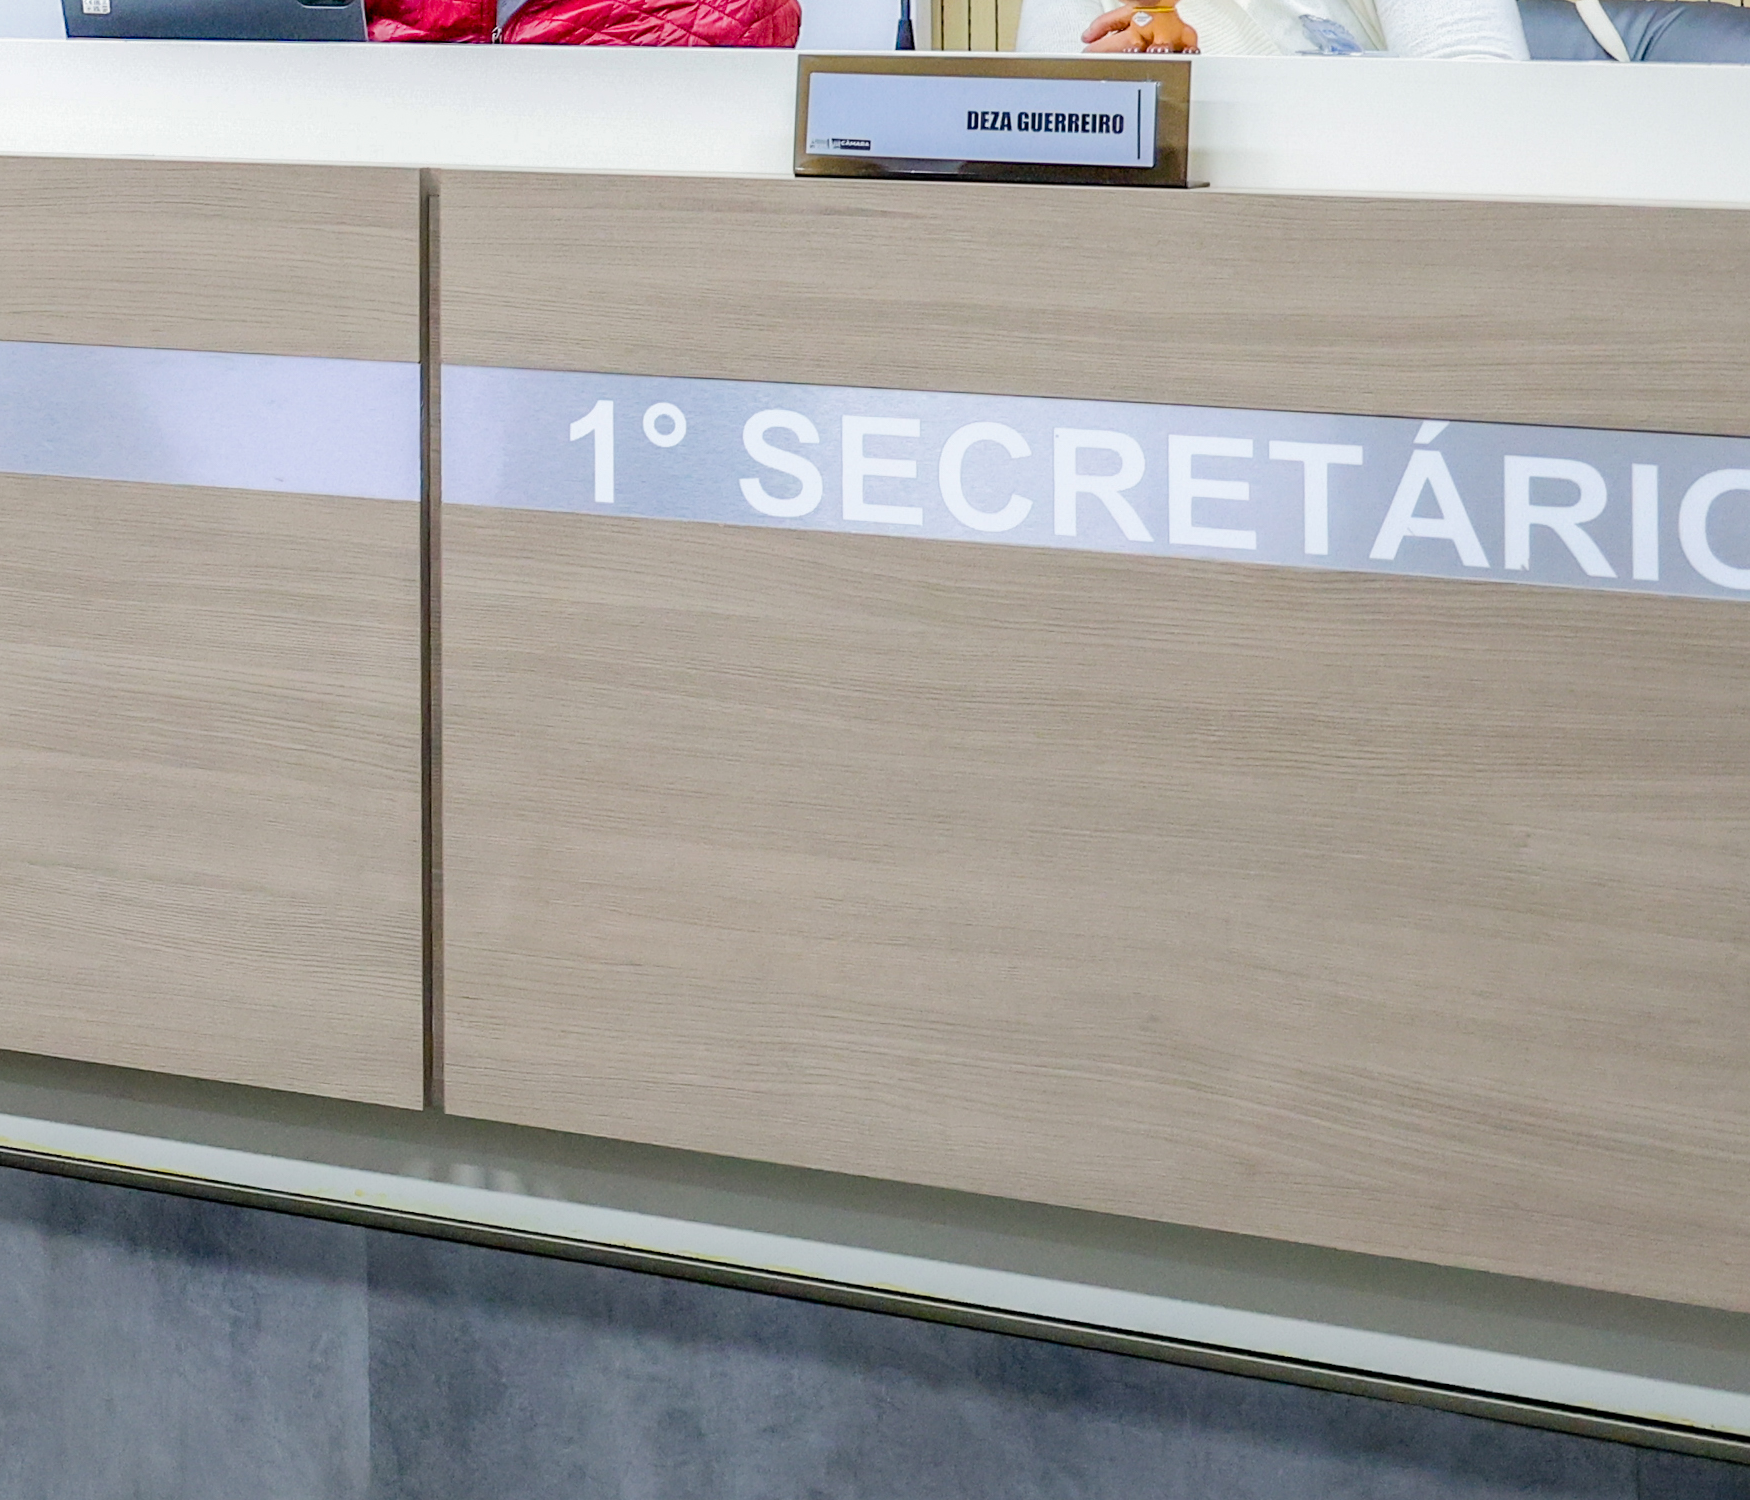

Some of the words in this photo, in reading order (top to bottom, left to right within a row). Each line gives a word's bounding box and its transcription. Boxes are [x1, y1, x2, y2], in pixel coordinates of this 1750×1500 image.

[966, 110, 1012, 132] DEZA
[1017, 111, 1125, 135] GUERREIRO
[737, 409, 1750, 591] SECRETÁRIO
